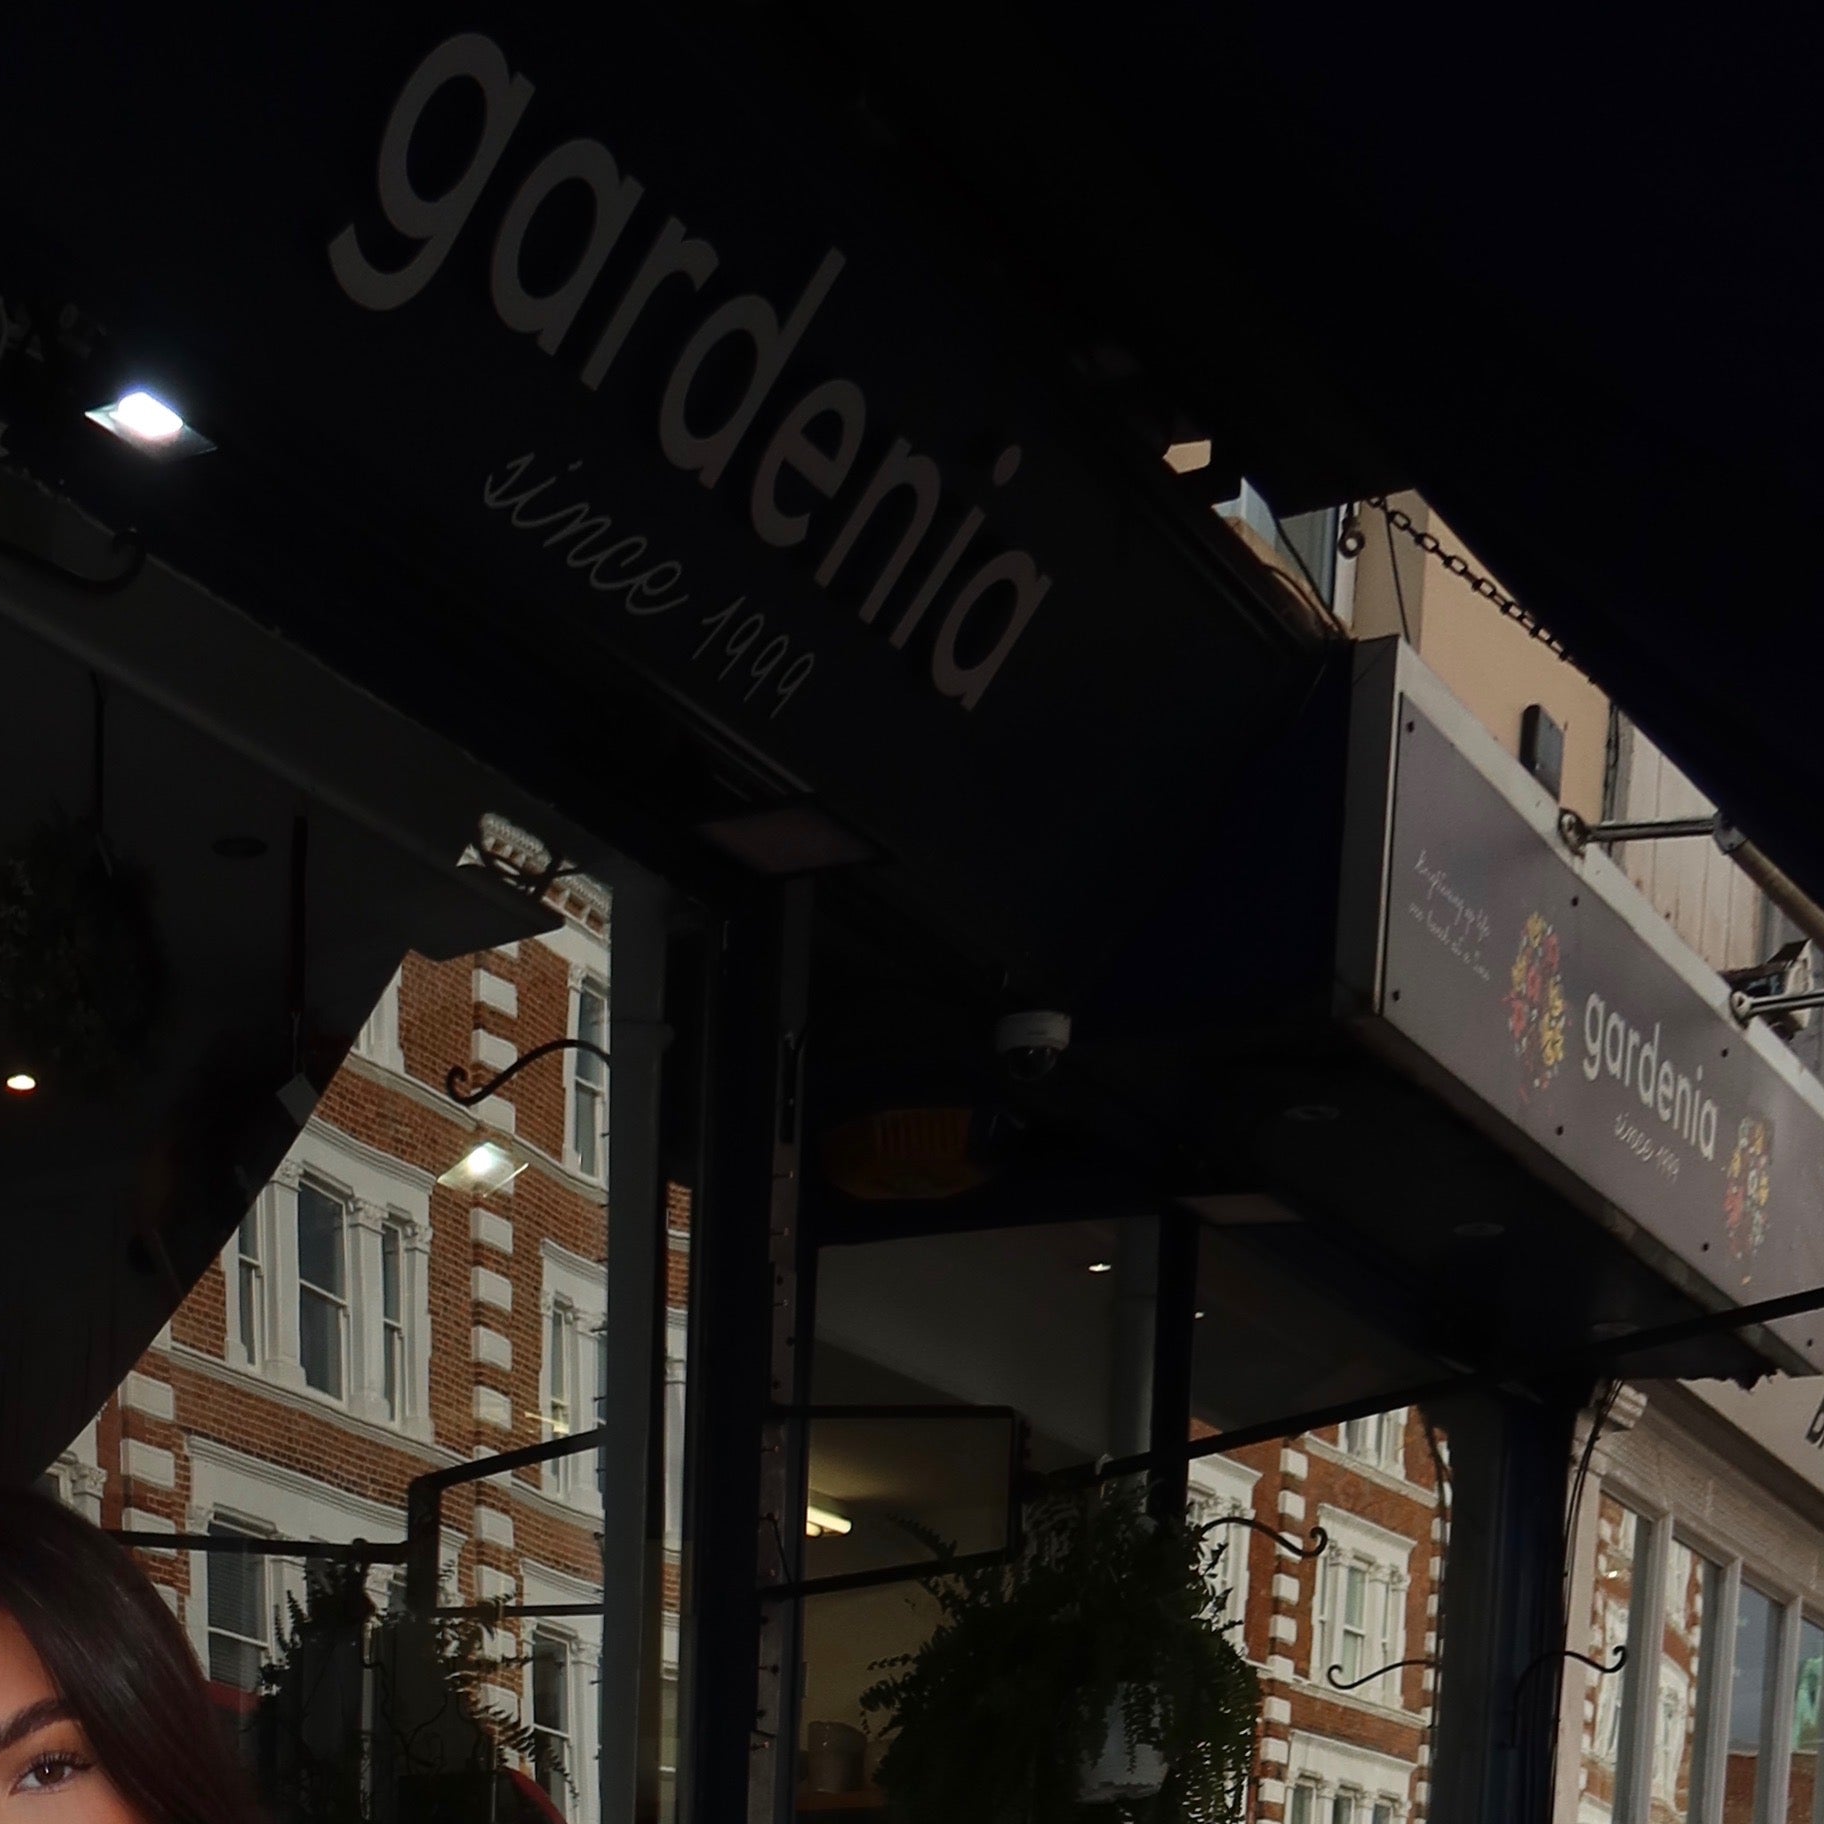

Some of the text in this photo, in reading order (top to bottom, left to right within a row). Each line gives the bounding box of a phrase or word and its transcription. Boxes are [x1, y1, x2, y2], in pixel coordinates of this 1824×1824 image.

[327, 32, 1052, 711] gardenia
[483, 453, 816, 719] since 1999
[1583, 992, 1718, 1162] gardenia
[1614, 1113, 1654, 1162] since
